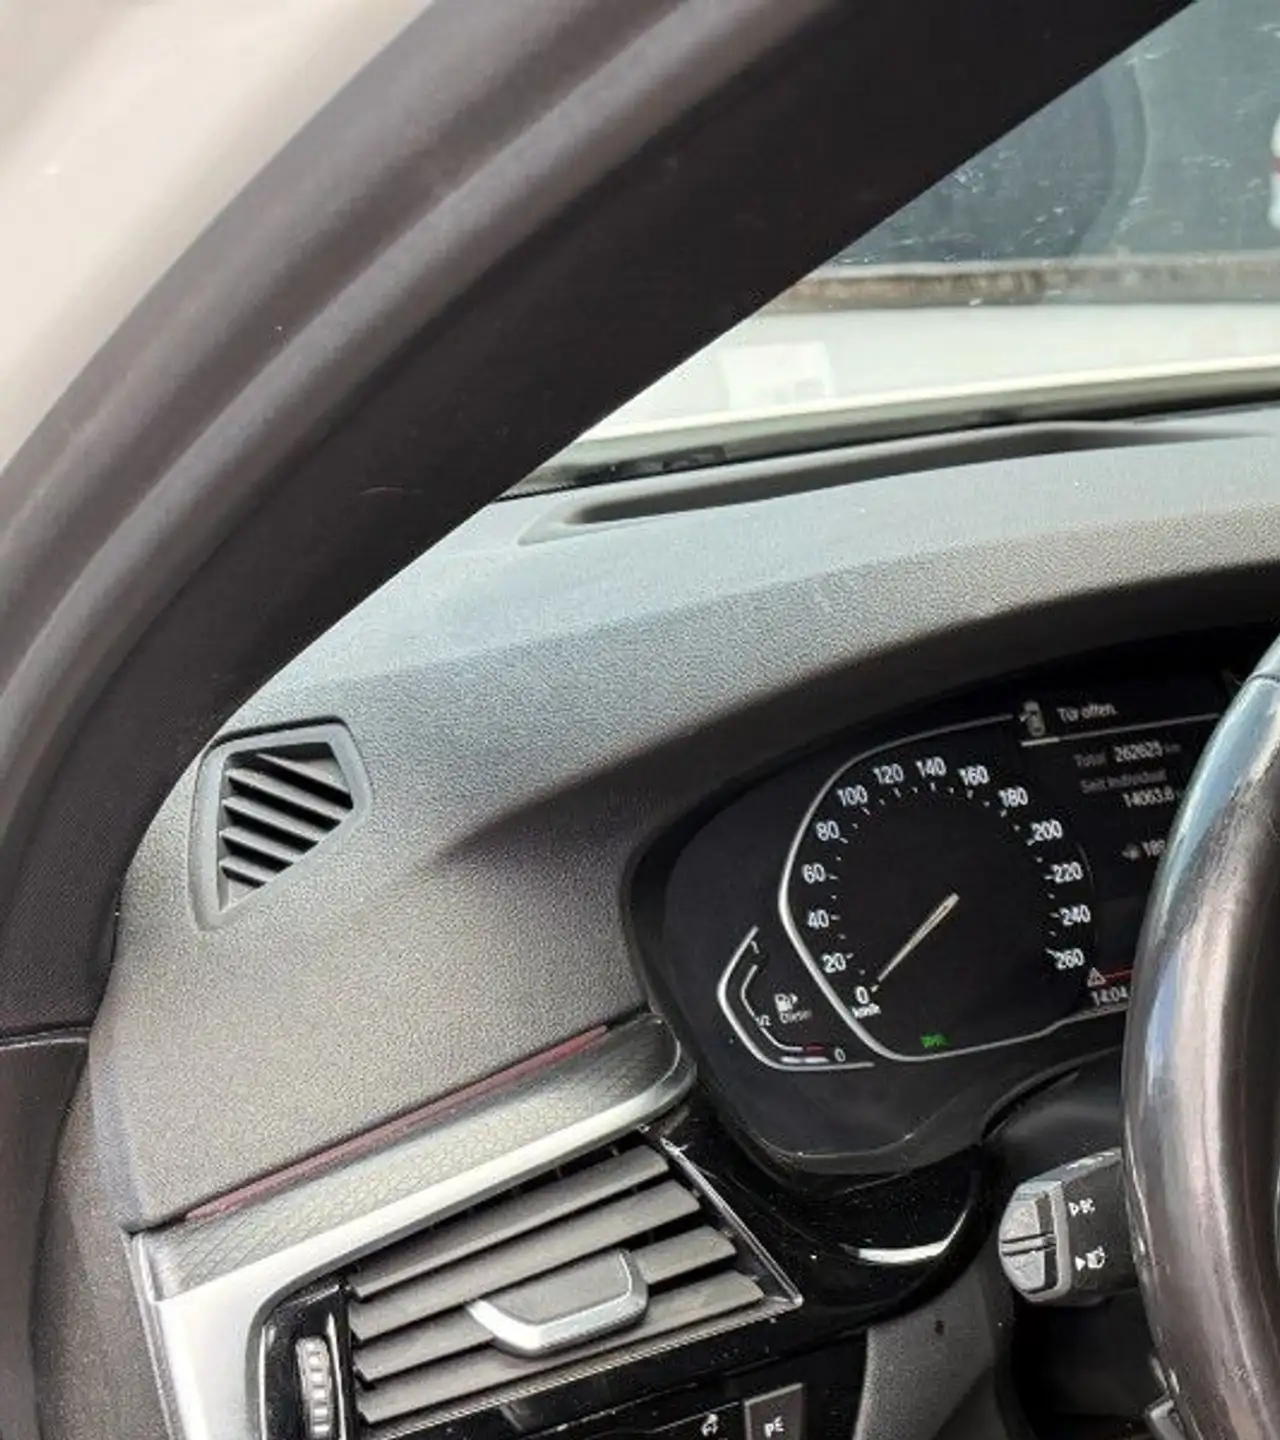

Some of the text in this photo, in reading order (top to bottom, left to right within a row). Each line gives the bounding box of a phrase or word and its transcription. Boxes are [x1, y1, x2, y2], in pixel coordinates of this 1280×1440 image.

[873, 763, 904, 785] 120
[916, 756, 946, 778] 140
[958, 765, 989, 786] 160
[836, 785, 868, 807] 100
[999, 786, 1029, 807] 180
[815, 820, 840, 841] 80
[1031, 819, 1063, 842] 200
[802, 863, 826, 883] 60
[1051, 861, 1083, 884] 220
[807, 909, 830, 928] 40
[1060, 904, 1091, 926] 240
[823, 953, 847, 974] 20
[1054, 948, 1085, 971] 260
[855, 985, 870, 1004] 0
[834, 1048, 847, 1062] 0
